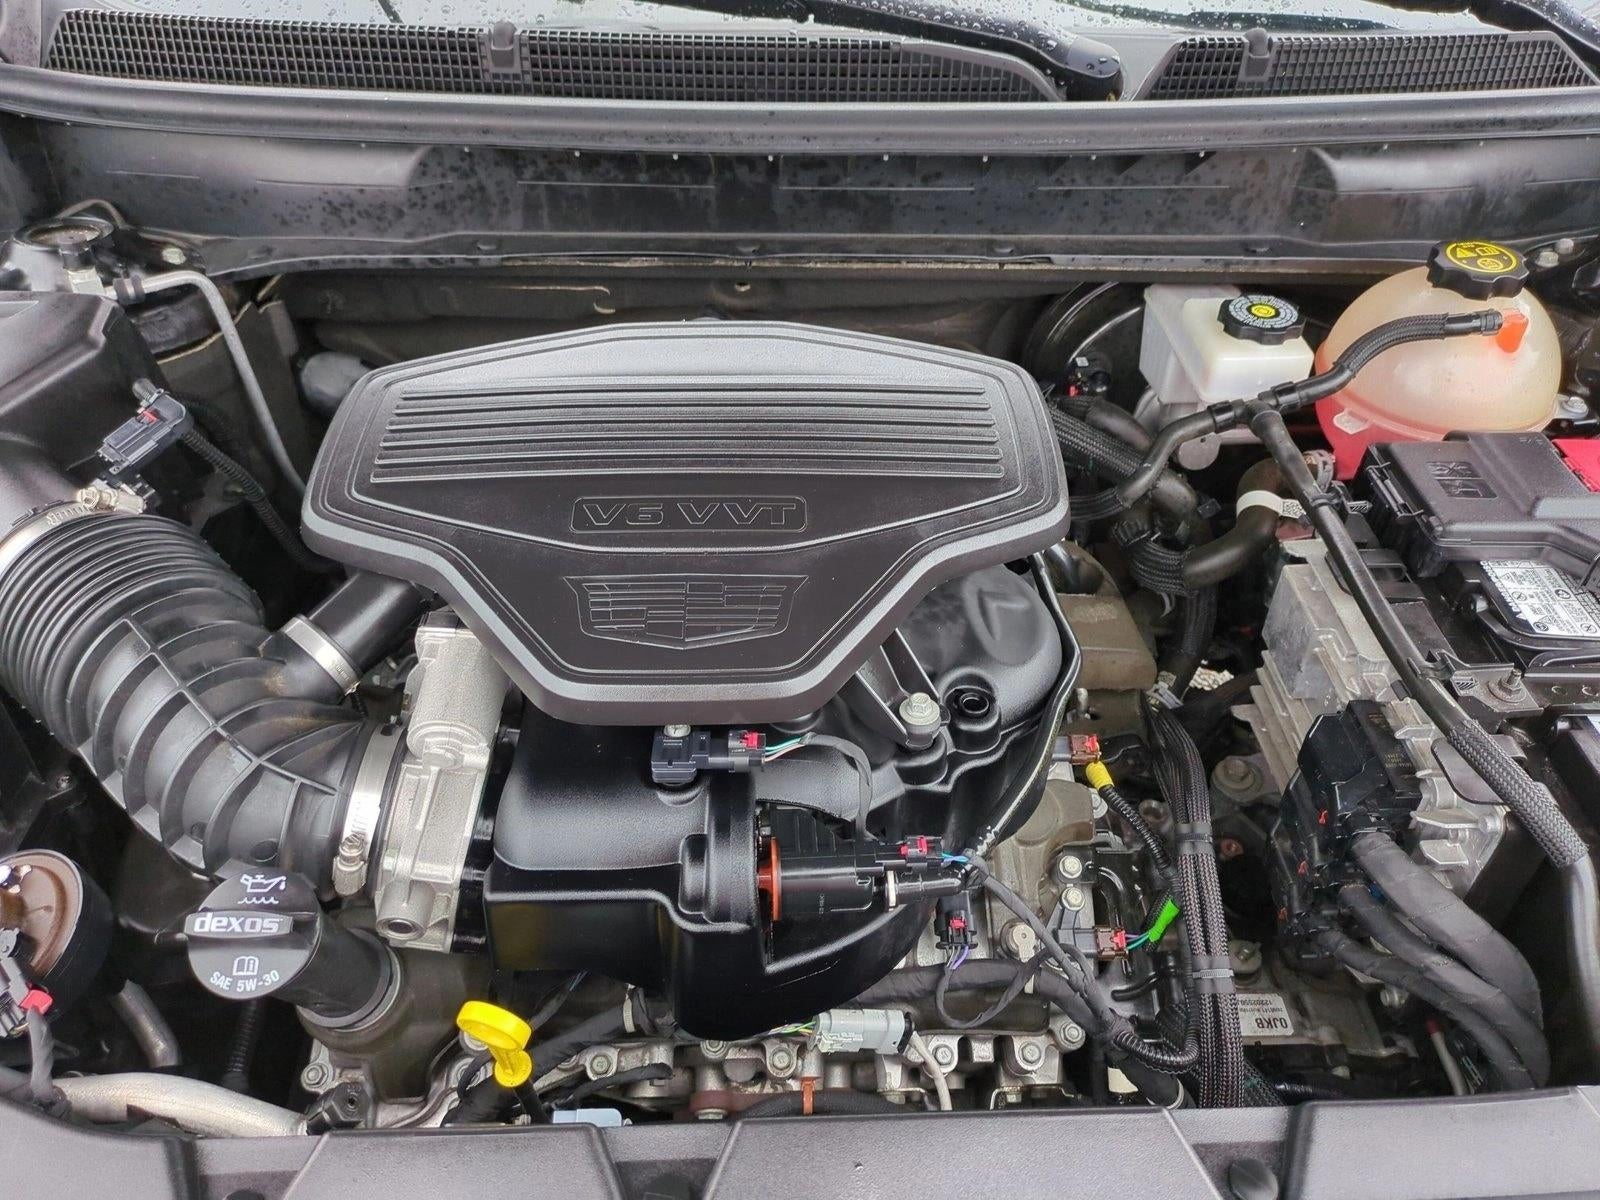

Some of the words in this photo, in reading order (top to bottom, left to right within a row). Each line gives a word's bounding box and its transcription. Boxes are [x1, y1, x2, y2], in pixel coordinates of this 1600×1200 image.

[582, 503, 664, 526] V6
[676, 502, 797, 525] VVT
[193, 912, 280, 934] dexos
[210, 970, 233, 991] SAE
[236, 969, 280, 993] 5W-30
